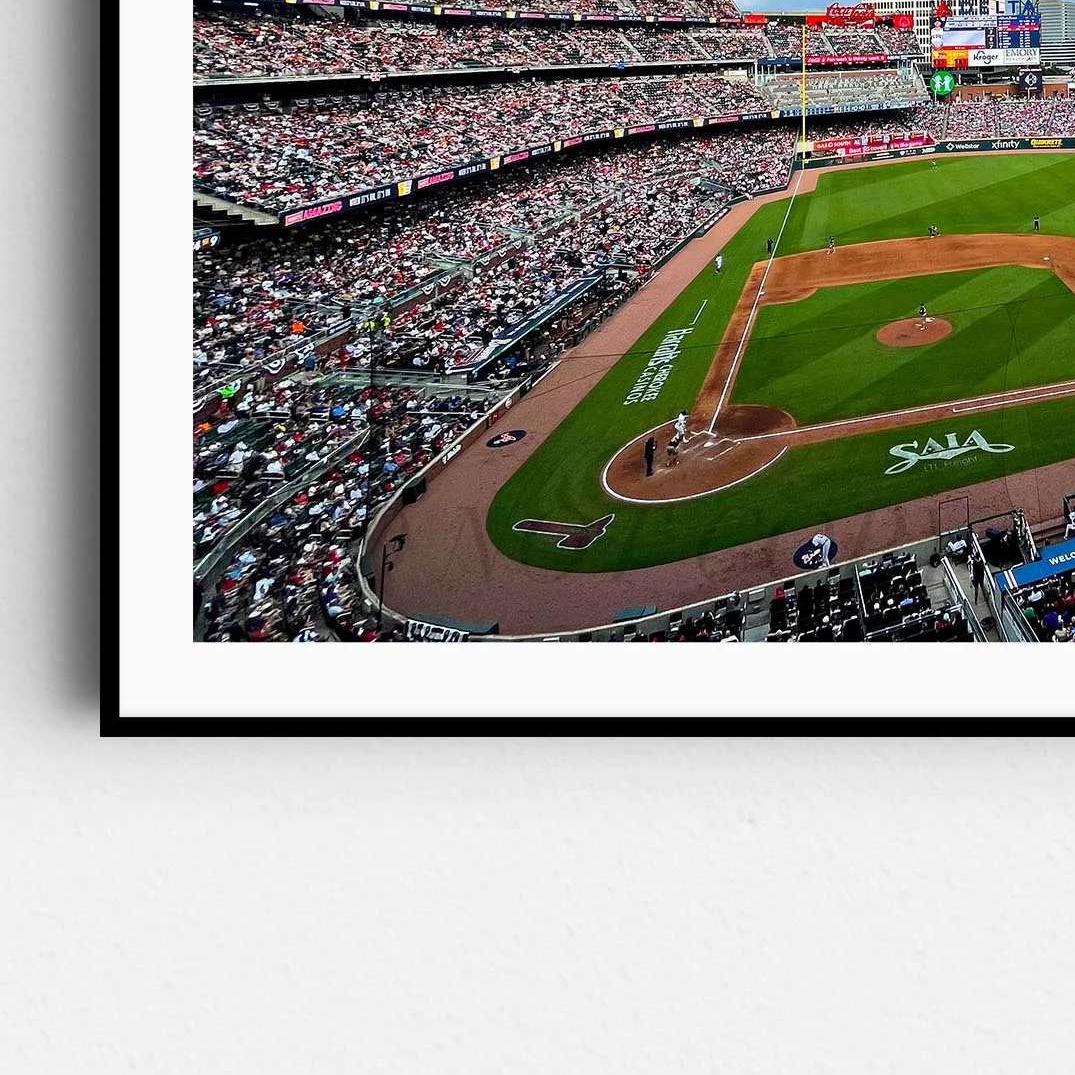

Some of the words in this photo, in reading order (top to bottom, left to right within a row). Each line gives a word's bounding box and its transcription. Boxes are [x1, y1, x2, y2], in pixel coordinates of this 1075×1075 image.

[959, 0, 1036, 16] DELTA
[973, 51, 998, 64] Kroger
[1005, 49, 1038, 57] EMORY
[955, 142, 980, 150] Wellstar
[991, 139, 1020, 150] xfinity
[623, 366, 657, 405] CASINOS
[884, 430, 1015, 474] SAIA
